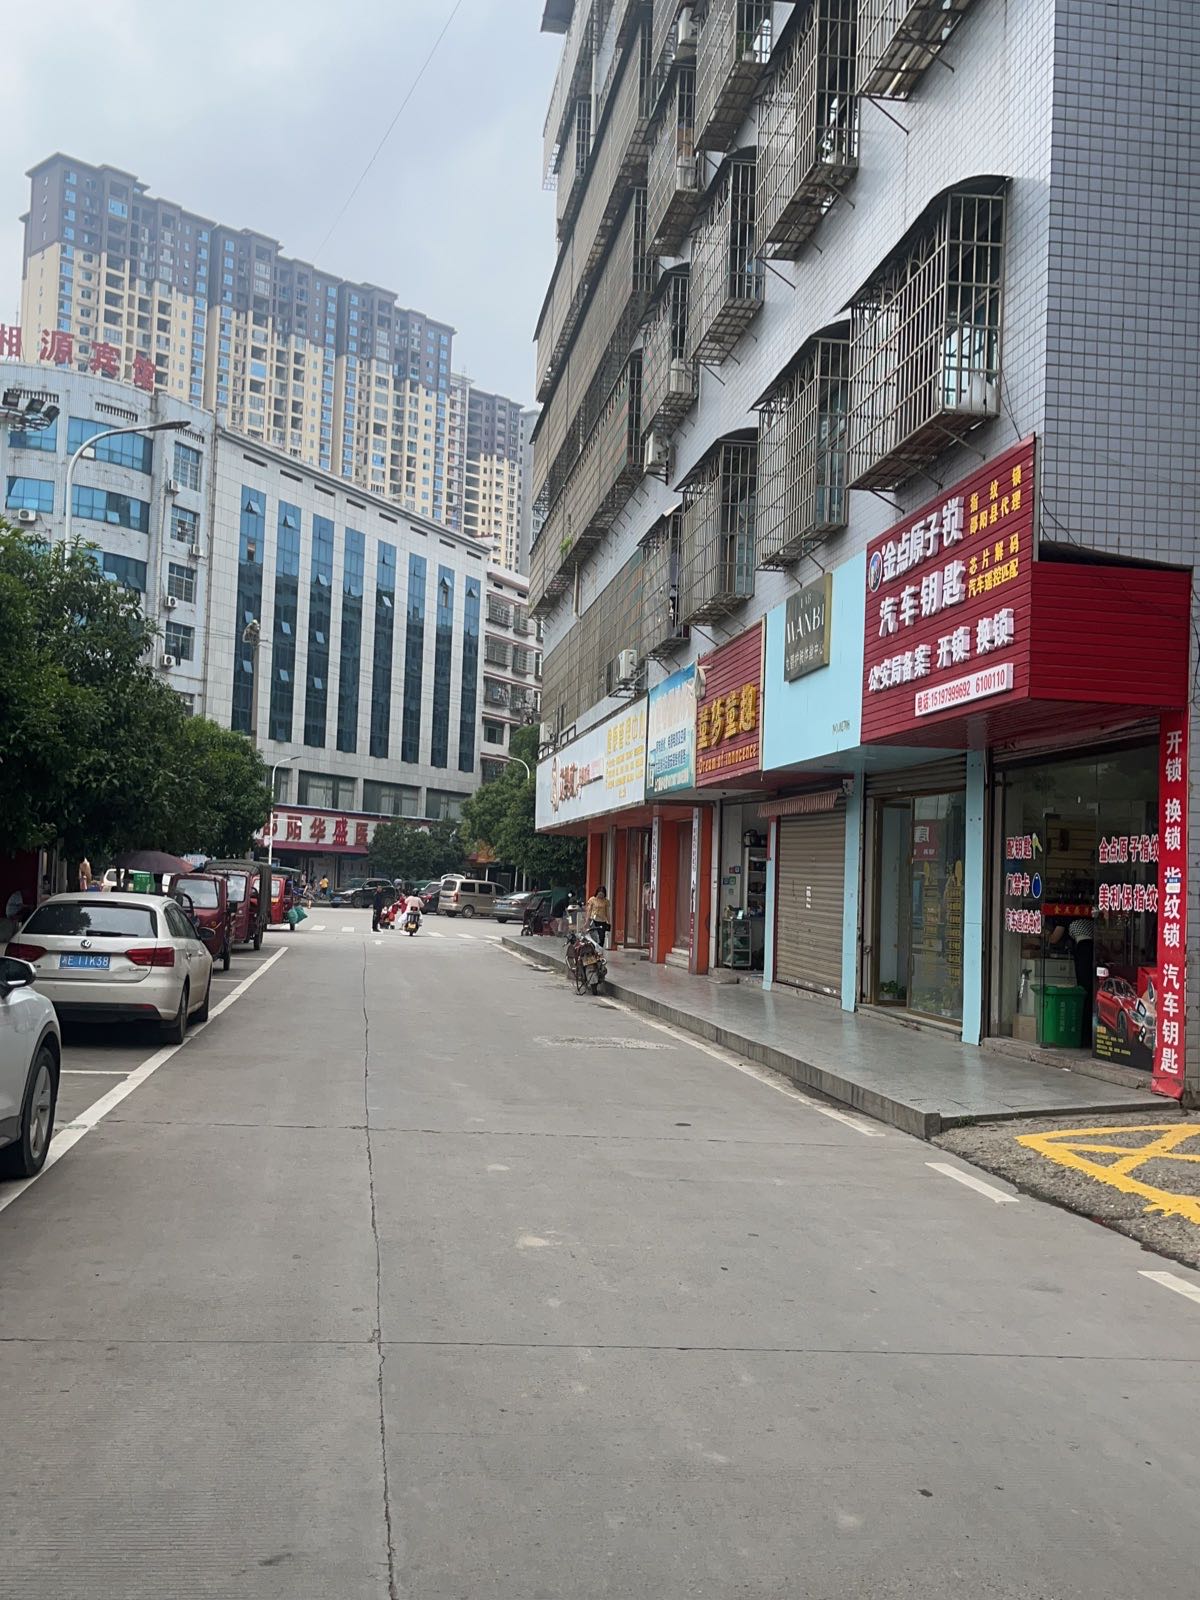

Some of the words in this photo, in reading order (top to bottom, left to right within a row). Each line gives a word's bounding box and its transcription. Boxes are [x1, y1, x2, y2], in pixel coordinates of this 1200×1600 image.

[969, 489, 1021, 535] 邵阳县代理
[882, 497, 964, 582] 金点原子锁
[968, 532, 1019, 575] 芯片解码
[879, 560, 966, 637] 汽车钥匙
[968, 557, 1019, 598] 汽车遥控匹配
[868, 644, 931, 692] 公安局备案
[937, 626, 970, 668] 开锁
[976, 608, 1014, 654] 换锁
[975, 669, 1005, 693] 6100110
[1165, 730, 1183, 783] 开锁
[1164, 797, 1182, 851] 换锁
[1006, 836, 1032, 860] 配钥匙
[1006, 872, 1031, 896] 门禁卡
[1098, 883, 1159, 913] 美利保指纹
[1160, 963, 1180, 1075] 汽车钥匙
